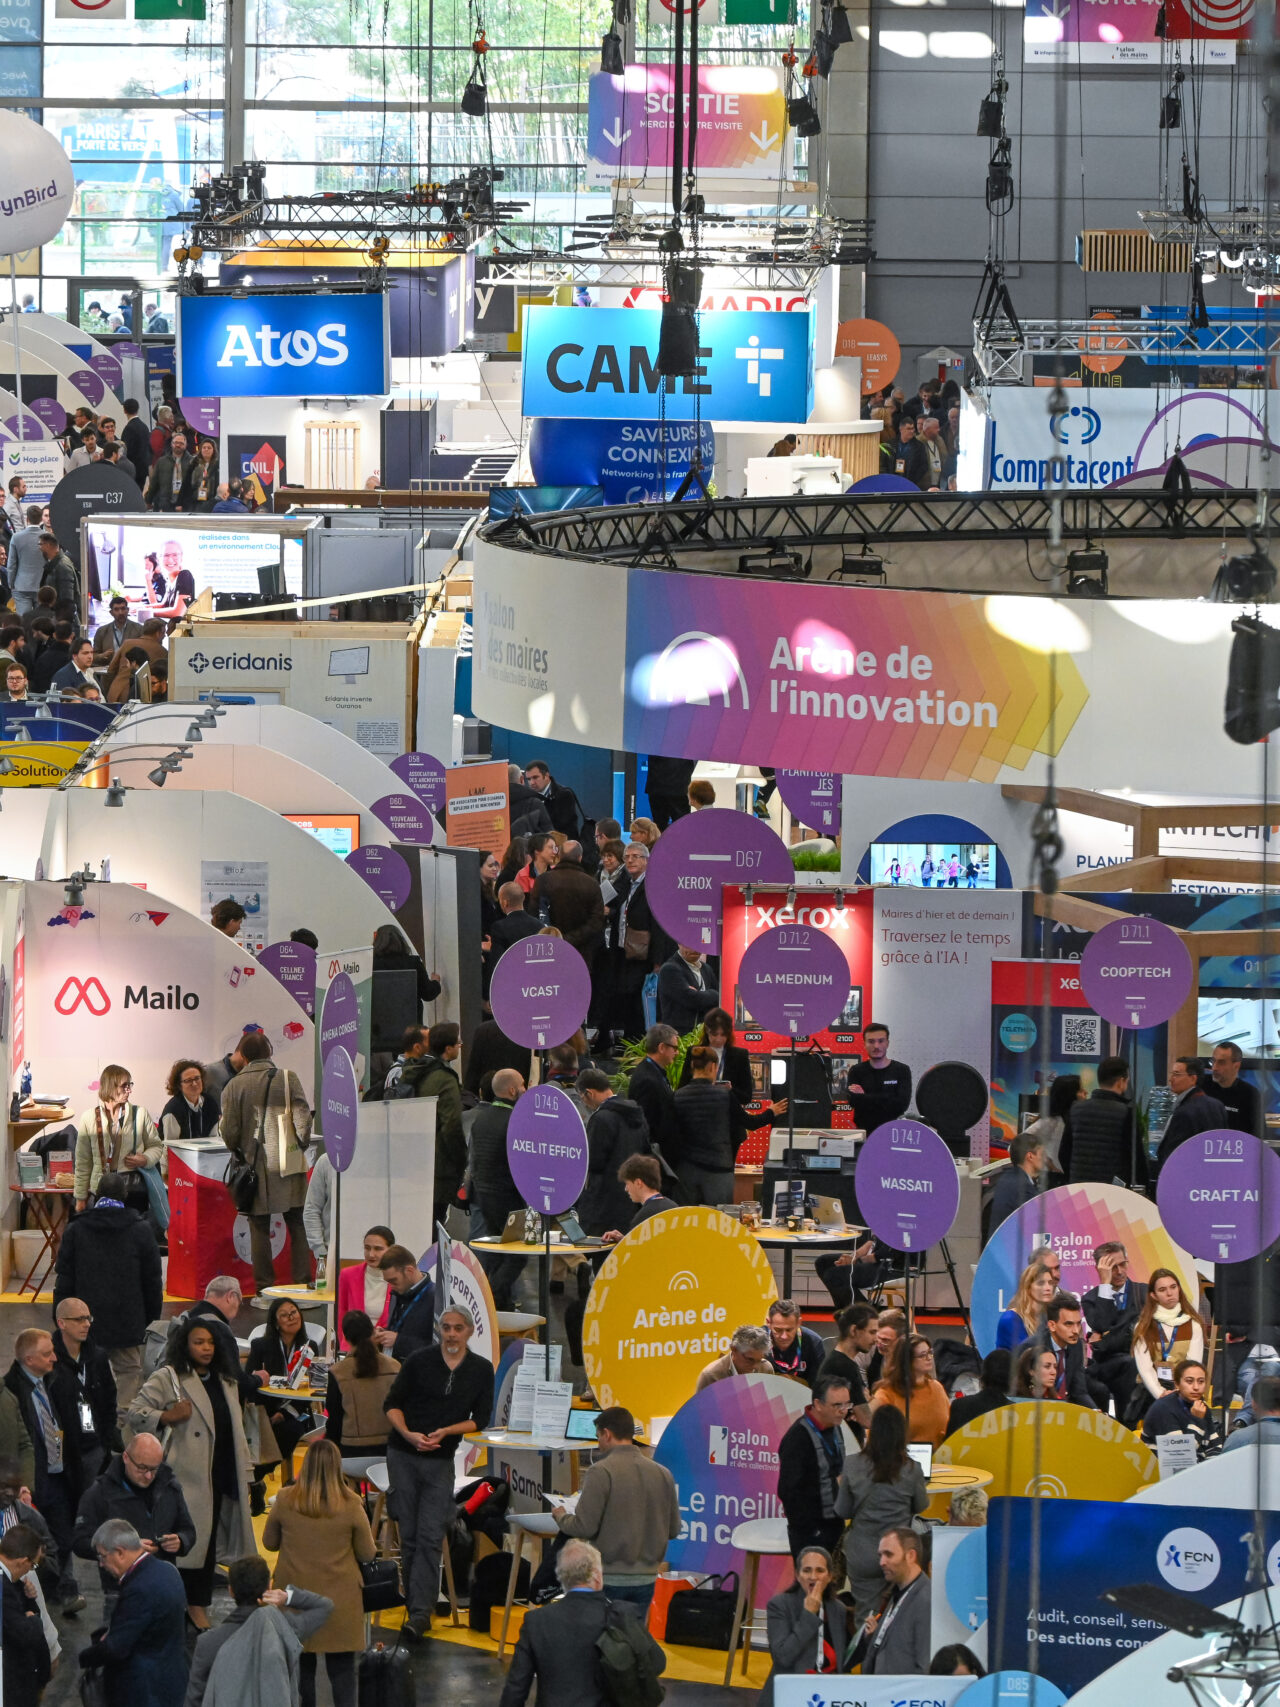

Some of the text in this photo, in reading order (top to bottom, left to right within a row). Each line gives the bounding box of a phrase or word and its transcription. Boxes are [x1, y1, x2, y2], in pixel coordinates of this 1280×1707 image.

[714, 121, 744, 131] VISITE
[546, 342, 713, 396] CAME
[621, 425, 698, 443] SAVEURS
[22, 455, 60, 465] Hop-place
[241, 460, 275, 476] CNIL.
[601, 467, 655, 480] Networking
[991, 453, 1135, 490] Computacent
[105, 492, 124, 504] C37
[209, 542, 263, 550] environnement
[212, 652, 293, 672] eridanis
[505, 637, 549, 674] maires
[769, 635, 933, 682] Arène de
[770, 679, 998, 728] l'innovation
[365, 847, 379, 857] D62
[734, 850, 762, 868] D67
[365, 866, 381, 875] ELIOZ
[677, 876, 713, 890] XEROX
[757, 907, 850, 929] xerox
[881, 909, 1009, 921] Maires d'hier et de demain
[788, 931, 810, 946] 71.2
[881, 928, 1011, 949] Traversez le temps
[279, 946, 294, 955] D64
[881, 948, 961, 968] grâce à l'IA
[279, 967, 306, 975] CELLNEX
[342, 961, 361, 976] Mailo
[1100, 966, 1172, 979] COOPTECH
[281, 974, 305, 982] FRANCE
[755, 973, 833, 986] LA MEDNUM
[122, 984, 201, 1012] Mailo
[521, 984, 560, 999] VCAST
[512, 1139, 582, 1161] AXEL EFFICY
[1216, 1140, 1244, 1156] 74.8
[880, 1176, 933, 1194] WASSATI
[1189, 1189, 1260, 1202] CRAFT AI
[1054, 1232, 1093, 1247] salon
[633, 1302, 727, 1330] Arène de
[730, 1432, 770, 1447] salon
[730, 1447, 755, 1461] des
[677, 1521, 707, 1543] en
[1184, 1551, 1214, 1563] FCN
[1026, 1608, 1069, 1624] Audit,
[1073, 1613, 1127, 1629] conseil,
[1026, 1628, 1113, 1648] Des actions
[1006, 1676, 1030, 1691] D85
